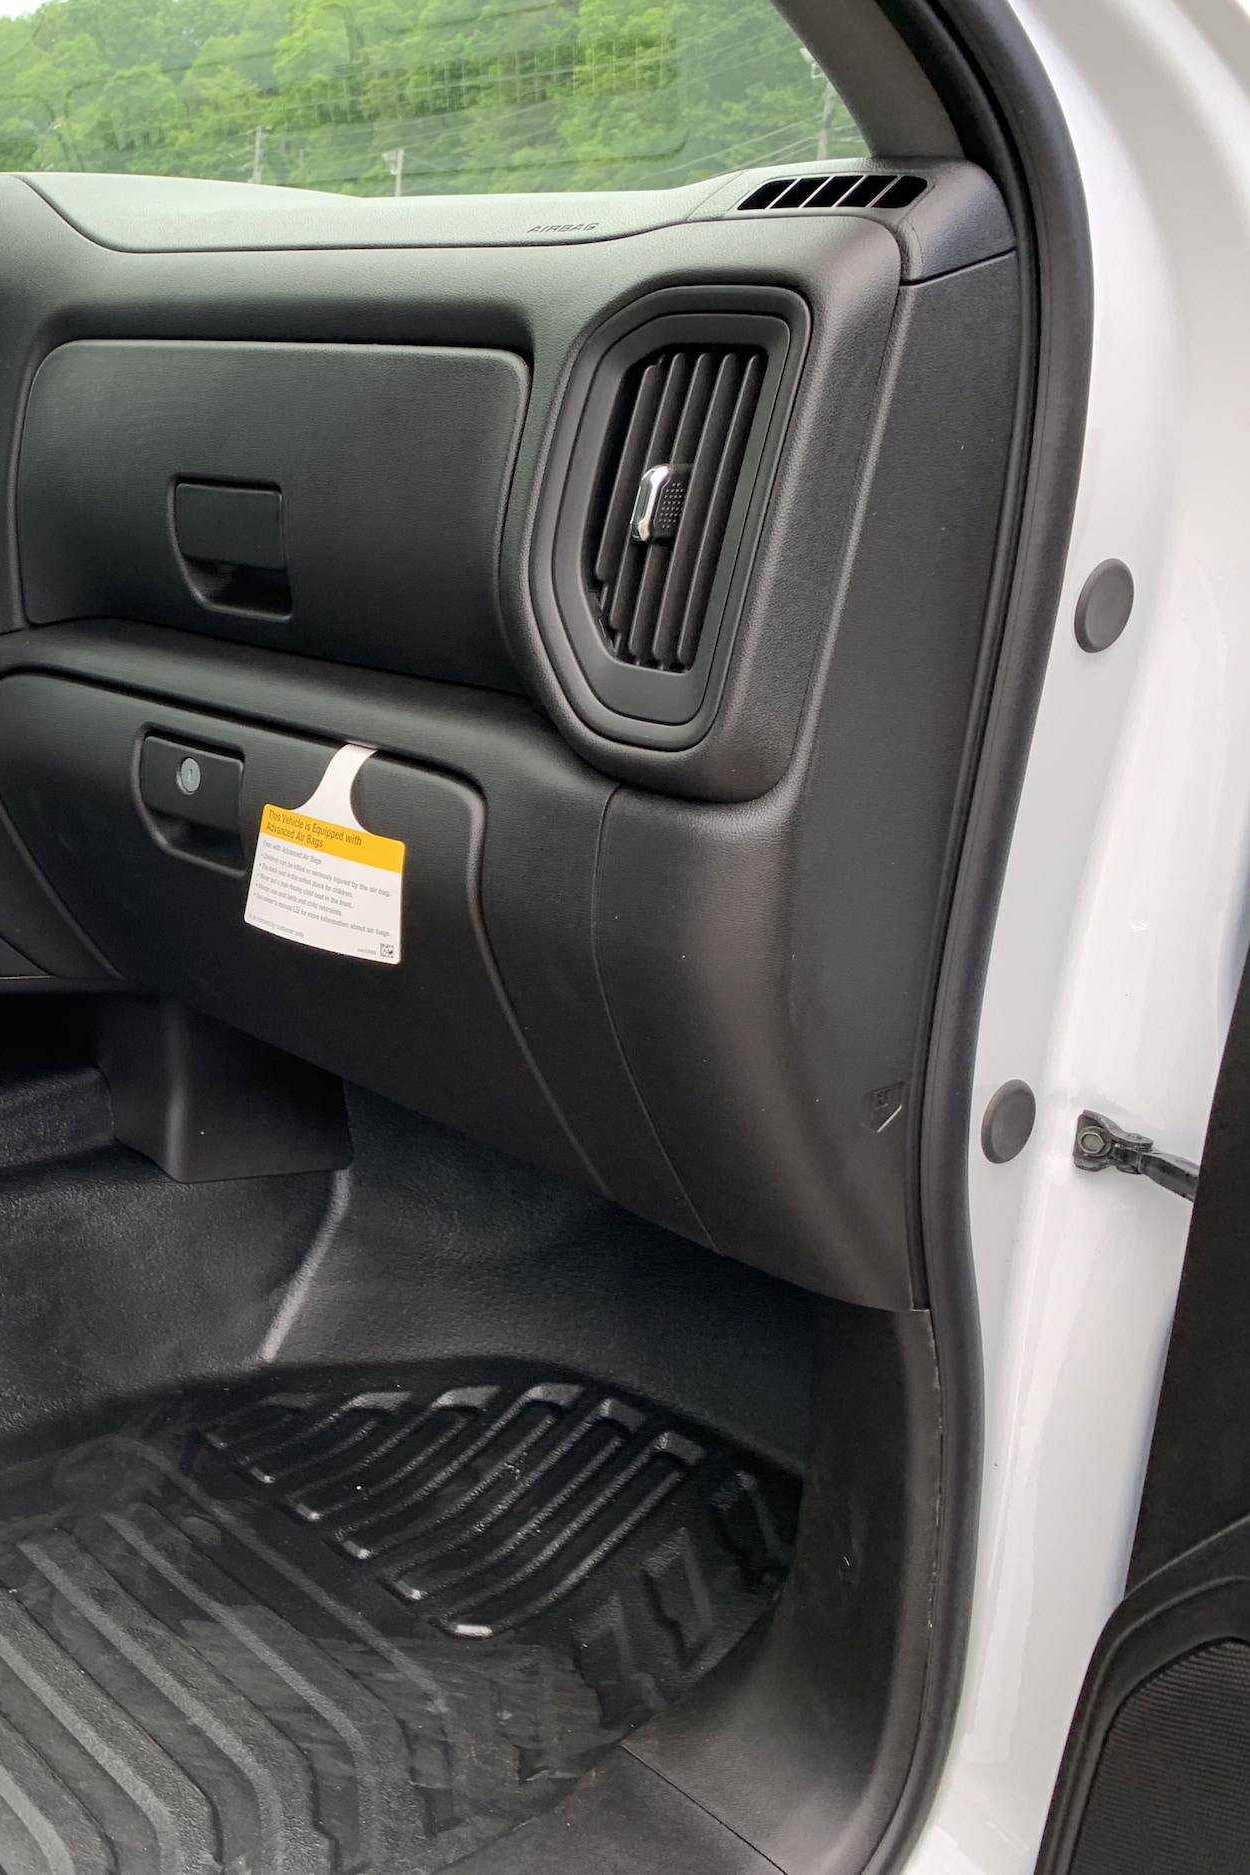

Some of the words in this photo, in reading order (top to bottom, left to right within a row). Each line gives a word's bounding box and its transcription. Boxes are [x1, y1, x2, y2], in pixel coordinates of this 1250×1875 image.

[527, 222, 599, 233] AIRBAG
[266, 821, 294, 838] Advanced
[295, 830, 305, 842] Air
[305, 833, 323, 849] Bags
[268, 809, 281, 821] This
[281, 813, 304, 828] Vehicle
[304, 821, 311, 831] is
[311, 822, 343, 843] Equipped
[345, 832, 362, 846] with
